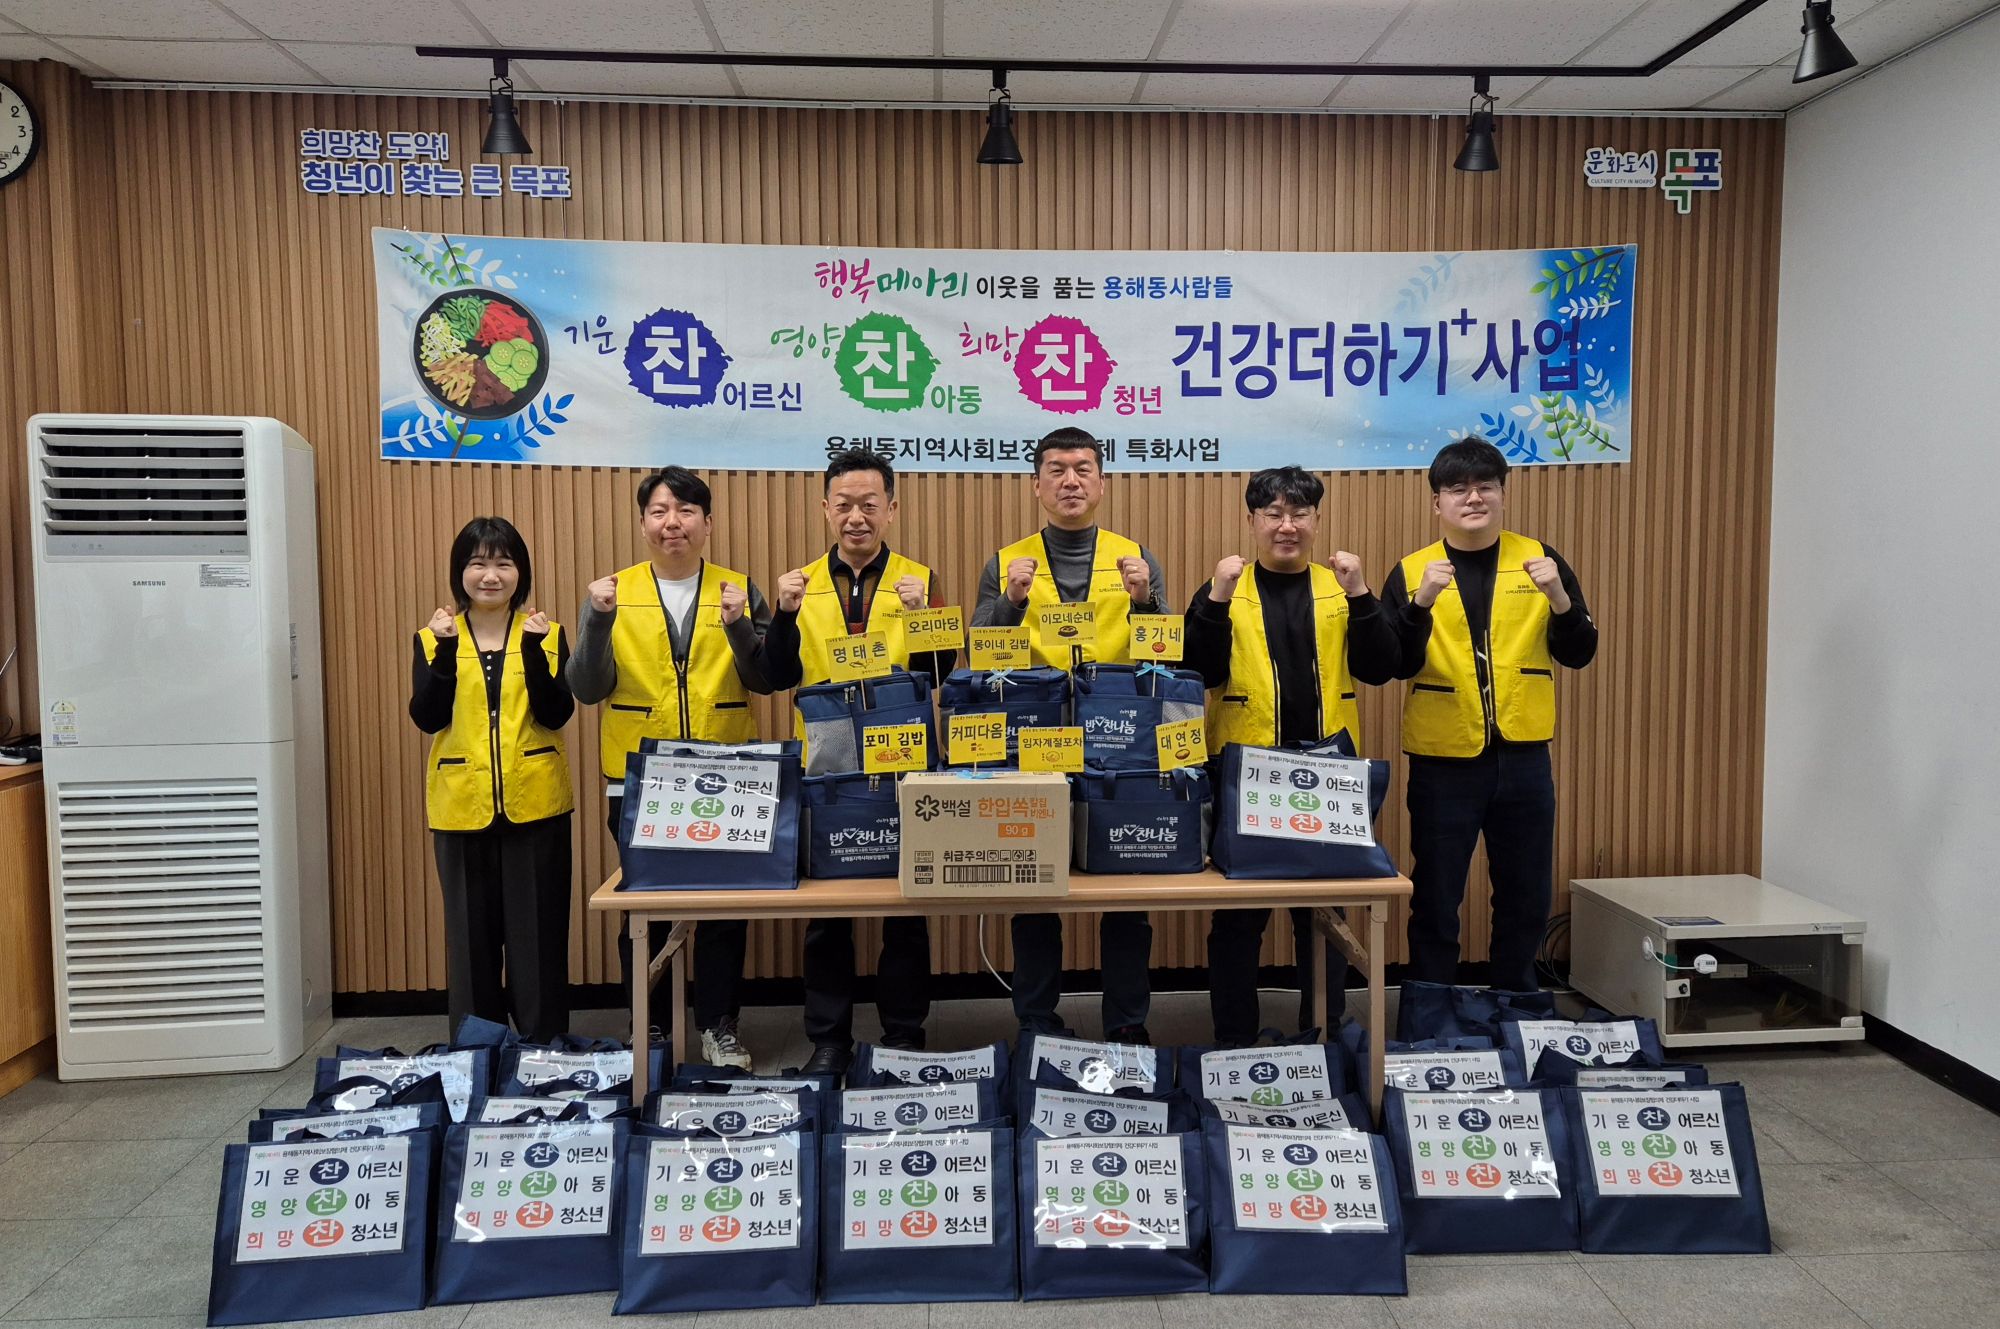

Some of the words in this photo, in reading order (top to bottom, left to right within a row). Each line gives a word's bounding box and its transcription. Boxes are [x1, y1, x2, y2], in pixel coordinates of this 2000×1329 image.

[11, 106, 19, 117] 2
[18, 126, 26, 137] 3
[12, 145, 20, 156] 4
[302, 129, 380, 158] 희망찬
[387, 132, 448, 160] 도약!
[303, 161, 393, 193] 청년이
[402, 163, 463, 195] 찾는
[472, 164, 501, 195] 큰
[511, 165, 570, 197] 목포
[1587, 151, 1655, 174] 문화도시
[1665, 152, 1719, 210] 목포
[814, 258, 968, 303] 행복메아리
[976, 275, 1040, 299] 이웃을
[1053, 276, 1096, 299] 품는
[1103, 276, 1233, 299] 용해동사람들
[564, 315, 617, 355] 기운
[642, 326, 707, 396] 찬
[723, 382, 802, 412] 어르신
[771, 323, 842, 358] 영양
[852, 325, 915, 400] 찬
[931, 385, 982, 415] 아동
[959, 322, 1019, 363] 희망
[1031, 333, 1093, 401] 찬
[1113, 385, 1161, 415] 청년
[1126, 438, 1219, 463] 특화사업
[909, 617, 959, 633] 오리마당
[1042, 611, 1094, 624] 이모네순대
[1010, 639, 1030, 650] 김밥
[865, 733, 890, 747] 포미
[898, 731, 924, 746] 김밥
[952, 723, 1003, 741] 커피다옴
[1023, 737, 1082, 748] 임자계절포차
[734, 780, 772, 795] 어르신
[1295, 771, 1314, 786] 찬
[1326, 777, 1363, 794] 어르신
[697, 798, 720, 816] 찬
[942, 800, 971, 818] 백설
[978, 797, 1029, 818] 한입쏙
[1295, 792, 1316, 809] 찬
[692, 822, 717, 839] 찬
[727, 828, 766, 842] 청소년
[1110, 828, 1178, 842] 반찬나눔
[1295, 814, 1317, 831] 찬
[1328, 822, 1366, 837] 청소년
[830, 829, 899, 846] 반찬나눔
[943, 850, 986, 862] 취급주의
[1571, 1037, 1586, 1052] 찬
[1598, 1040, 1635, 1055] 어르신
[575, 1072, 594, 1087] 찬
[924, 1067, 943, 1080] 찬
[955, 1066, 990, 1080] 어르신
[1254, 1065, 1274, 1080] 찬
[1286, 1065, 1323, 1080] 어르신
[1430, 1070, 1450, 1084] 찬
[1462, 1071, 1500, 1086] 어르신
[720, 1114, 740, 1130] 찬
[901, 1105, 922, 1121] 찬
[935, 1104, 974, 1121] 어르신
[1090, 1112, 1111, 1129] 찬
[1464, 1111, 1485, 1127] 찬
[1499, 1115, 1540, 1130] 어르신
[1643, 1110, 1664, 1126] 찬
[1678, 1113, 1720, 1128] 어르신
[1467, 1135, 1490, 1156] 찬
[1647, 1135, 1671, 1155] 찬
[531, 1146, 554, 1163] 찬
[567, 1147, 608, 1164] 어르신
[908, 1154, 930, 1171] 찬
[944, 1156, 986, 1173] 어르신
[1289, 1147, 1312, 1161] 찬
[1325, 1149, 1368, 1164] 어르신
[317, 1161, 342, 1180] 찬
[357, 1161, 402, 1179] 어르신
[713, 1161, 736, 1178] 찬
[751, 1159, 793, 1178] 어르신
[1099, 1156, 1120, 1172] 찬
[1135, 1159, 1176, 1175] 어르신
[1471, 1164, 1495, 1185] 찬
[1652, 1162, 1678, 1184] 찬
[1689, 1169, 1731, 1185] 청소년
[526, 1172, 552, 1195] 찬
[1293, 1169, 1318, 1188] 찬
[313, 1188, 341, 1212] 찬
[711, 1187, 737, 1209] 찬
[907, 1181, 932, 1204] 찬
[1099, 1181, 1124, 1202] 찬
[522, 1202, 549, 1224] 찬
[560, 1206, 603, 1224] 청소년
[1295, 1196, 1322, 1217] 찬
[1334, 1203, 1377, 1219] 청소년
[309, 1220, 339, 1244] 찬
[351, 1222, 397, 1242] 청소년
[708, 1216, 736, 1239] 찬
[748, 1219, 792, 1238] 청소년
[906, 1211, 932, 1234] 찬
[944, 1216, 987, 1234] 청소년
